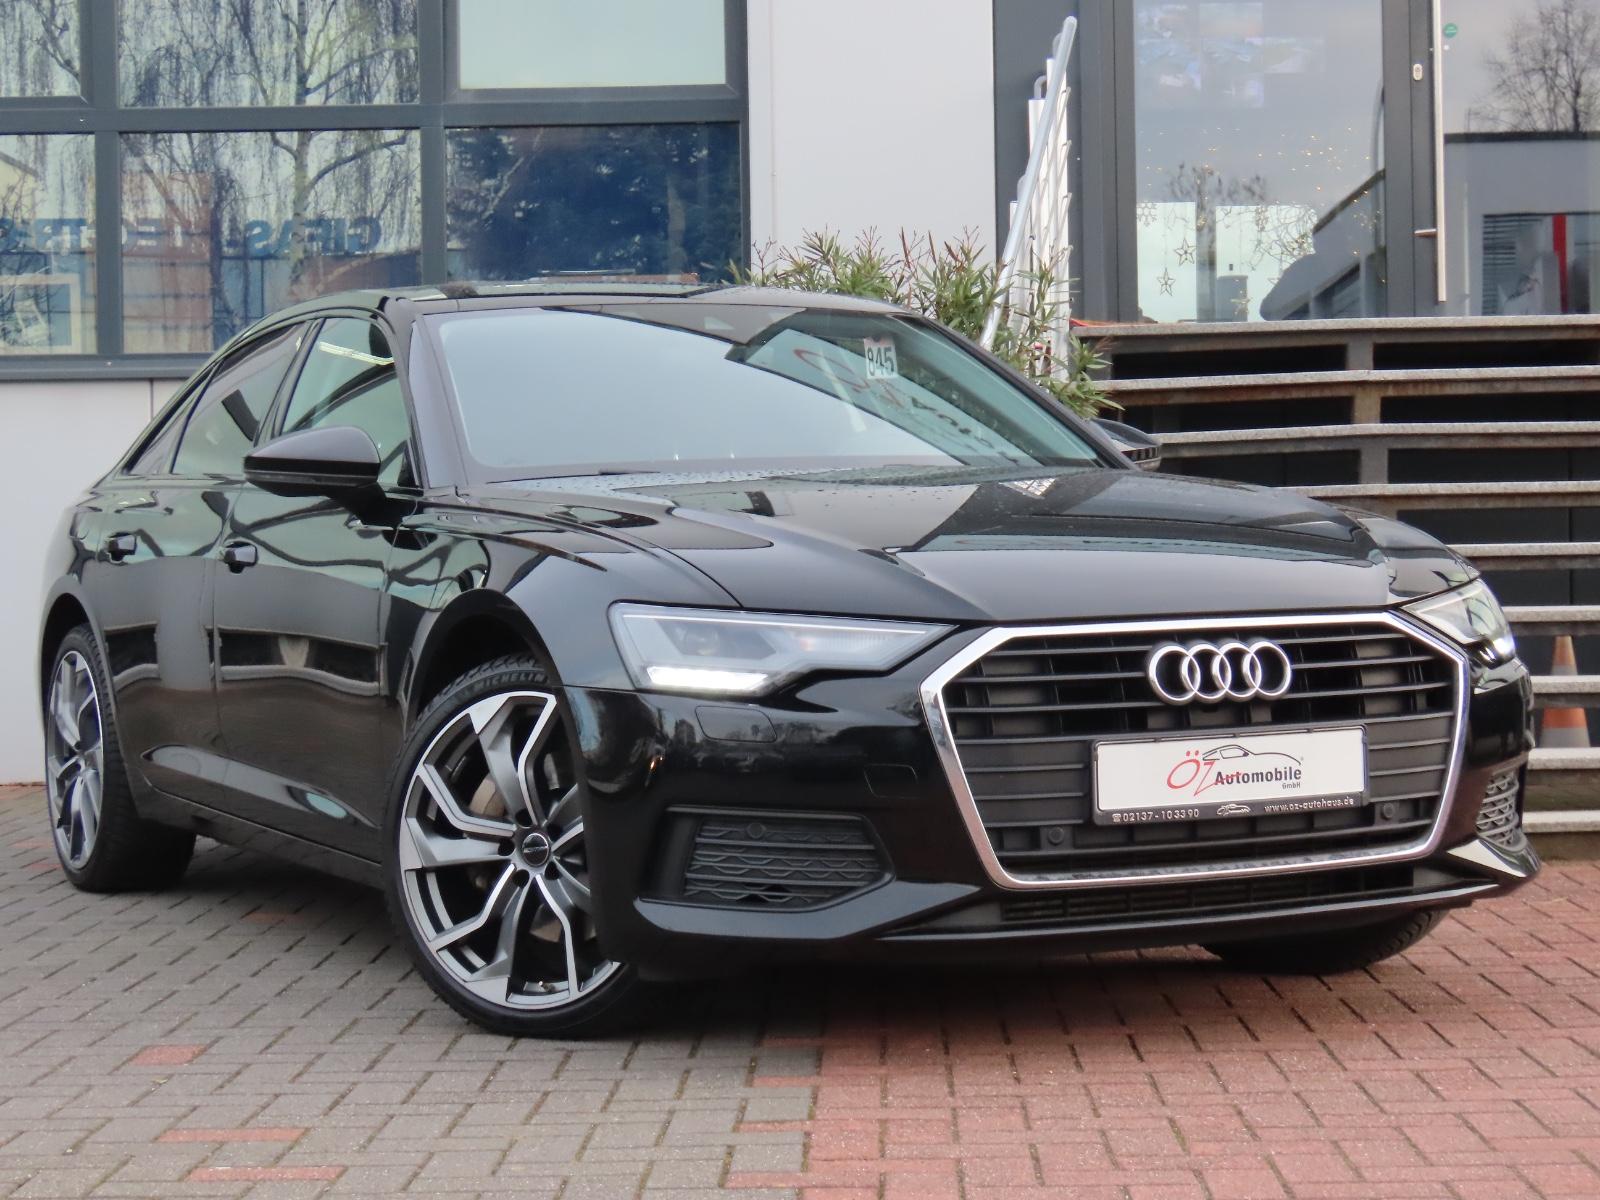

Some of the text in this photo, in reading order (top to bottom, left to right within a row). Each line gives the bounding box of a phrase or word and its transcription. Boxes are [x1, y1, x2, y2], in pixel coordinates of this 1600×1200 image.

[866, 346, 895, 377] 845
[1214, 766, 1302, 786] Automobile
[1281, 782, 1301, 790] GmbH
